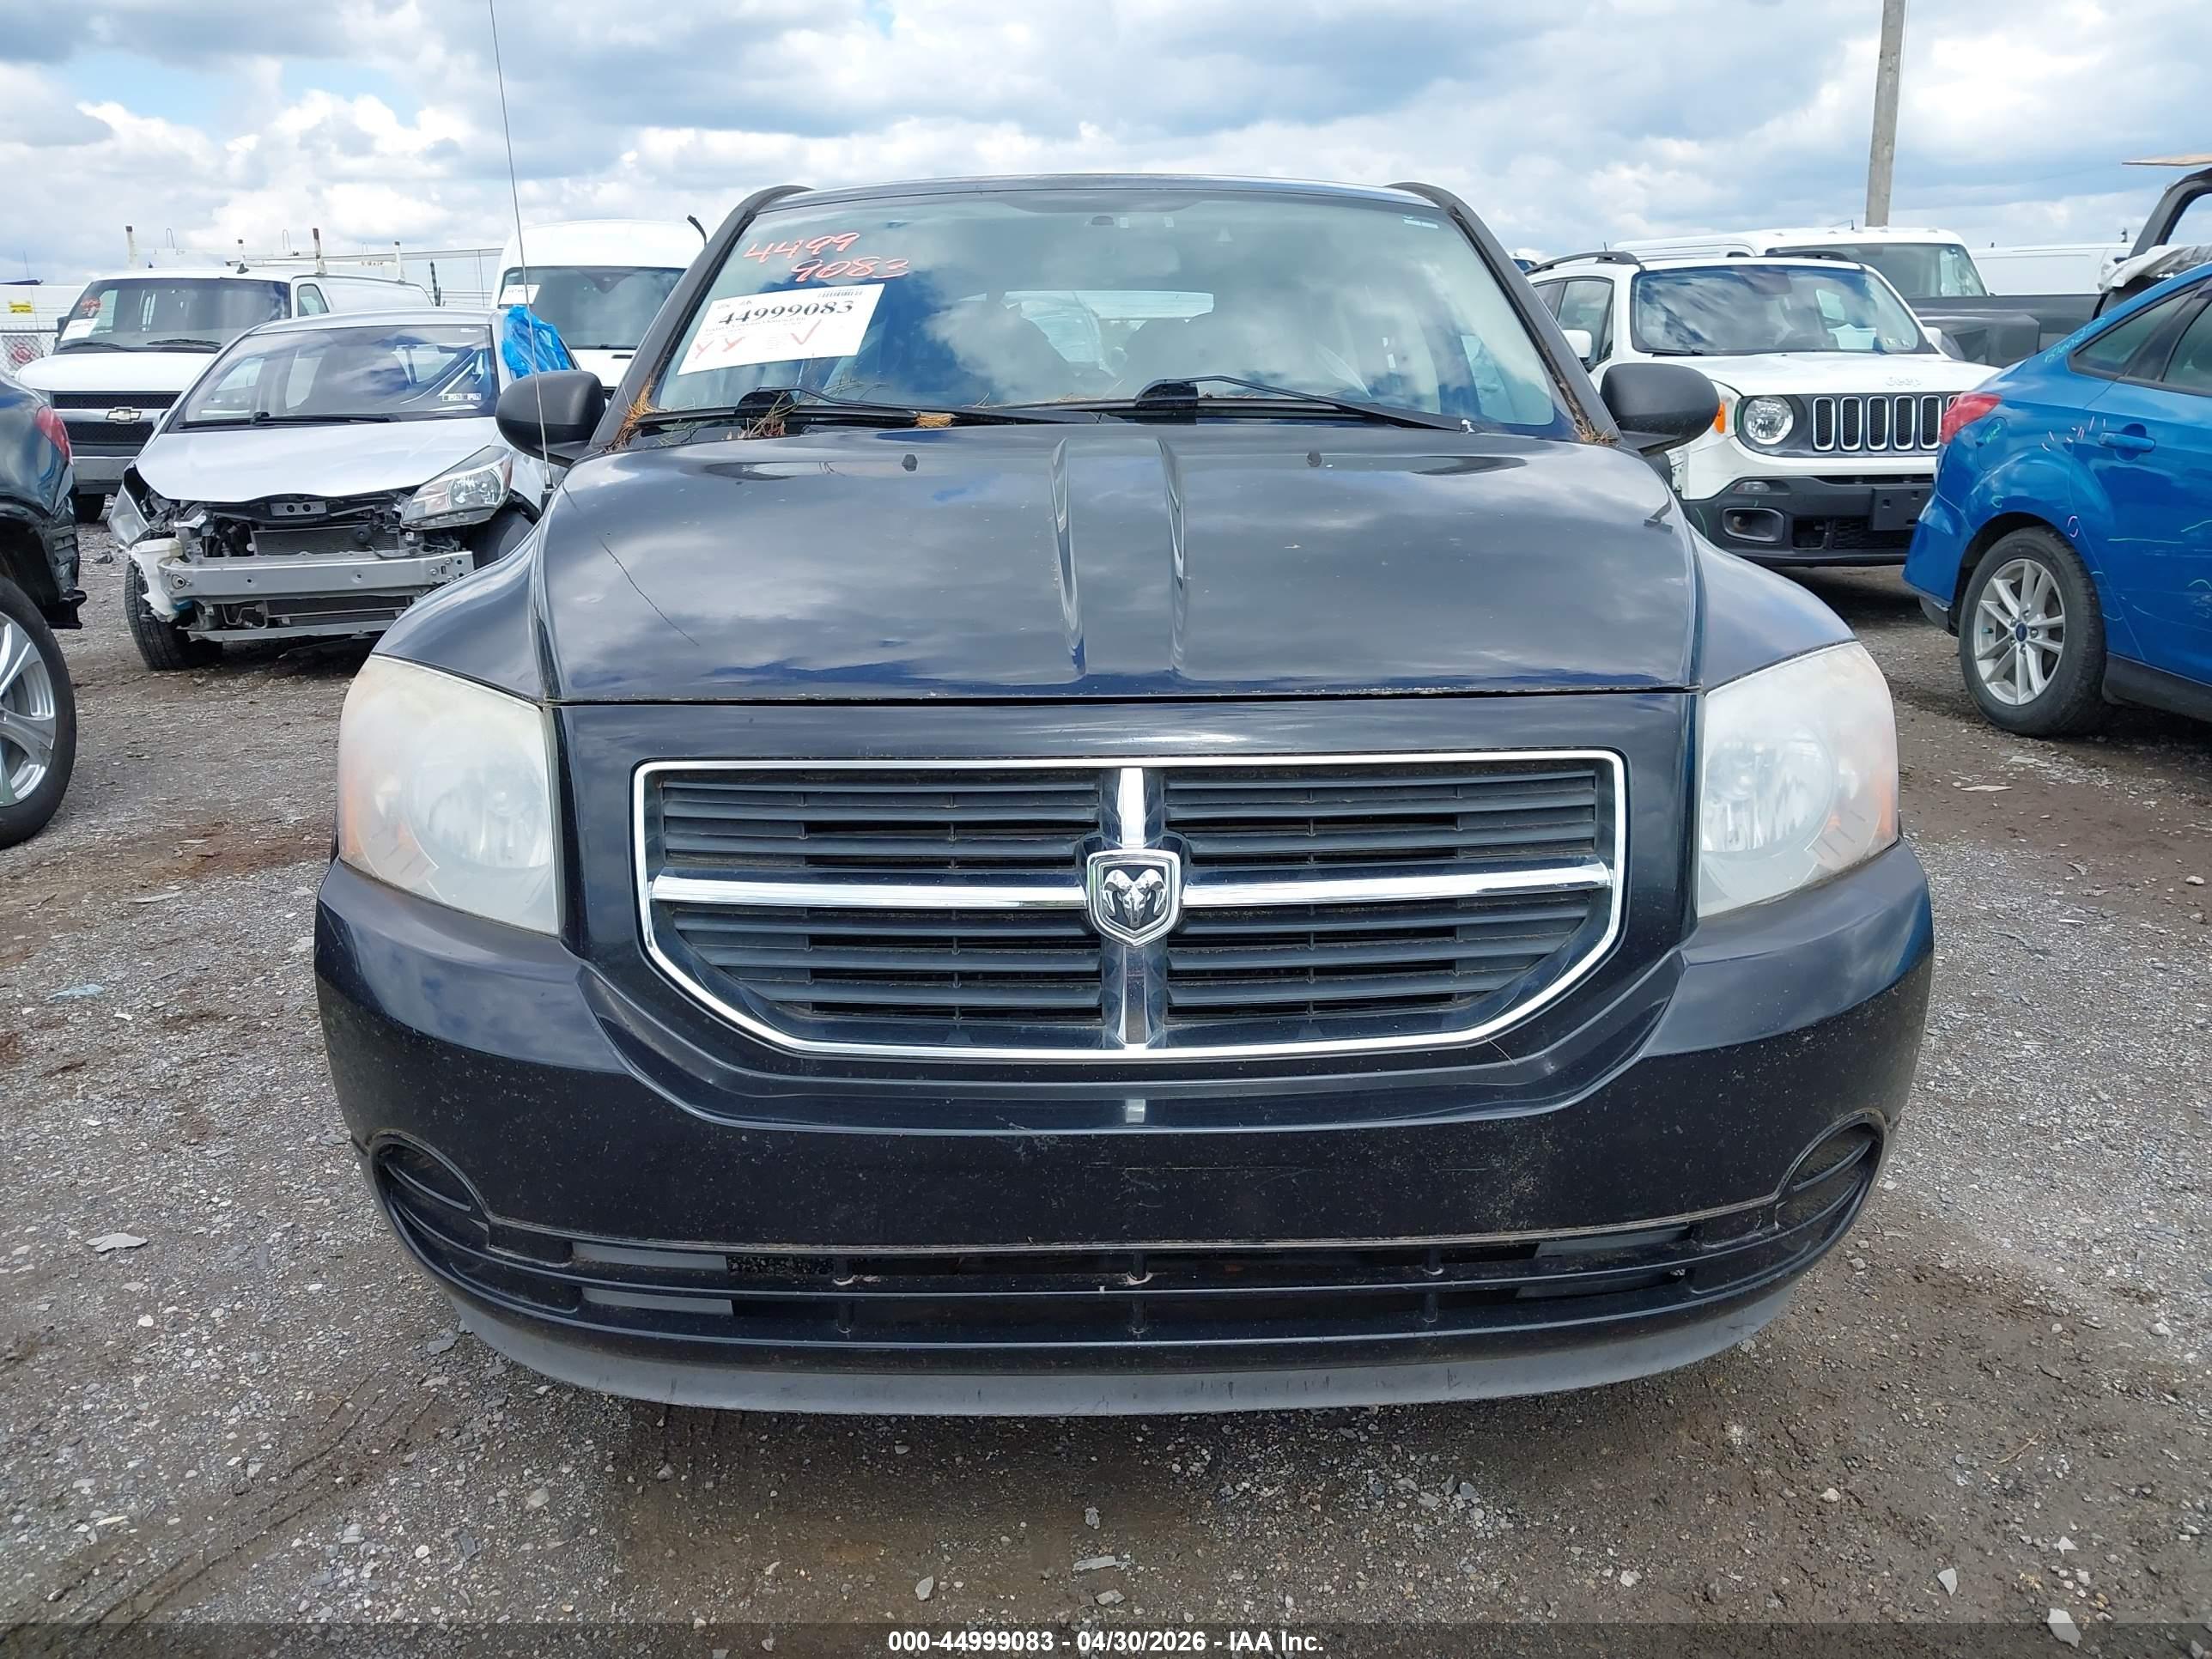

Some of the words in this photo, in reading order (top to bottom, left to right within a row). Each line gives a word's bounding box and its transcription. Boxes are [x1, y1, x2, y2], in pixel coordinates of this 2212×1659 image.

[744, 232, 860, 263] 4499
[790, 257, 909, 283] 9083
[718, 300, 854, 325] 44999083
